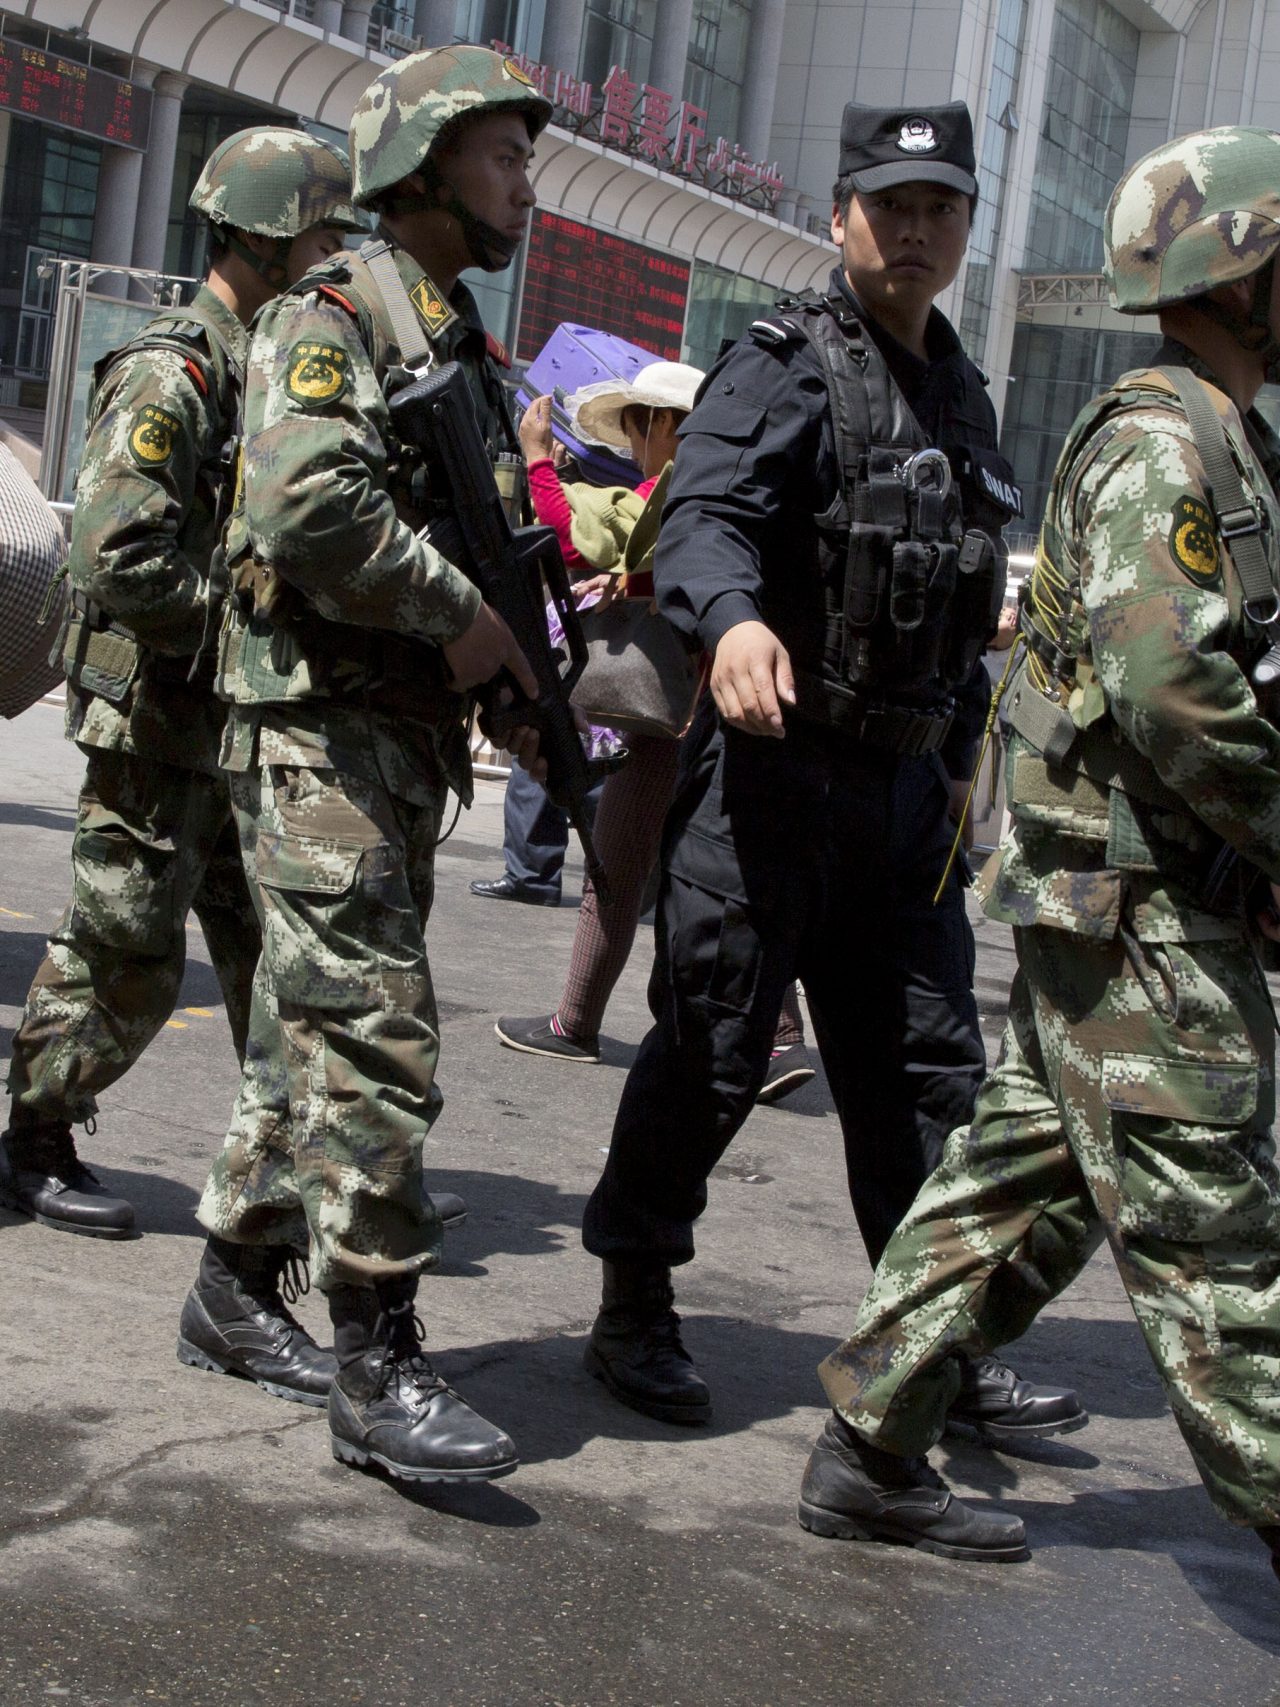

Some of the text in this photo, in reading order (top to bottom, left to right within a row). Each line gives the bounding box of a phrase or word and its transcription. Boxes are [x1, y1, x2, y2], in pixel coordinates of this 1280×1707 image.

[554, 70, 592, 117] Hall
[602, 65, 708, 172] 售票厅
[981, 467, 1022, 513] SWAT
